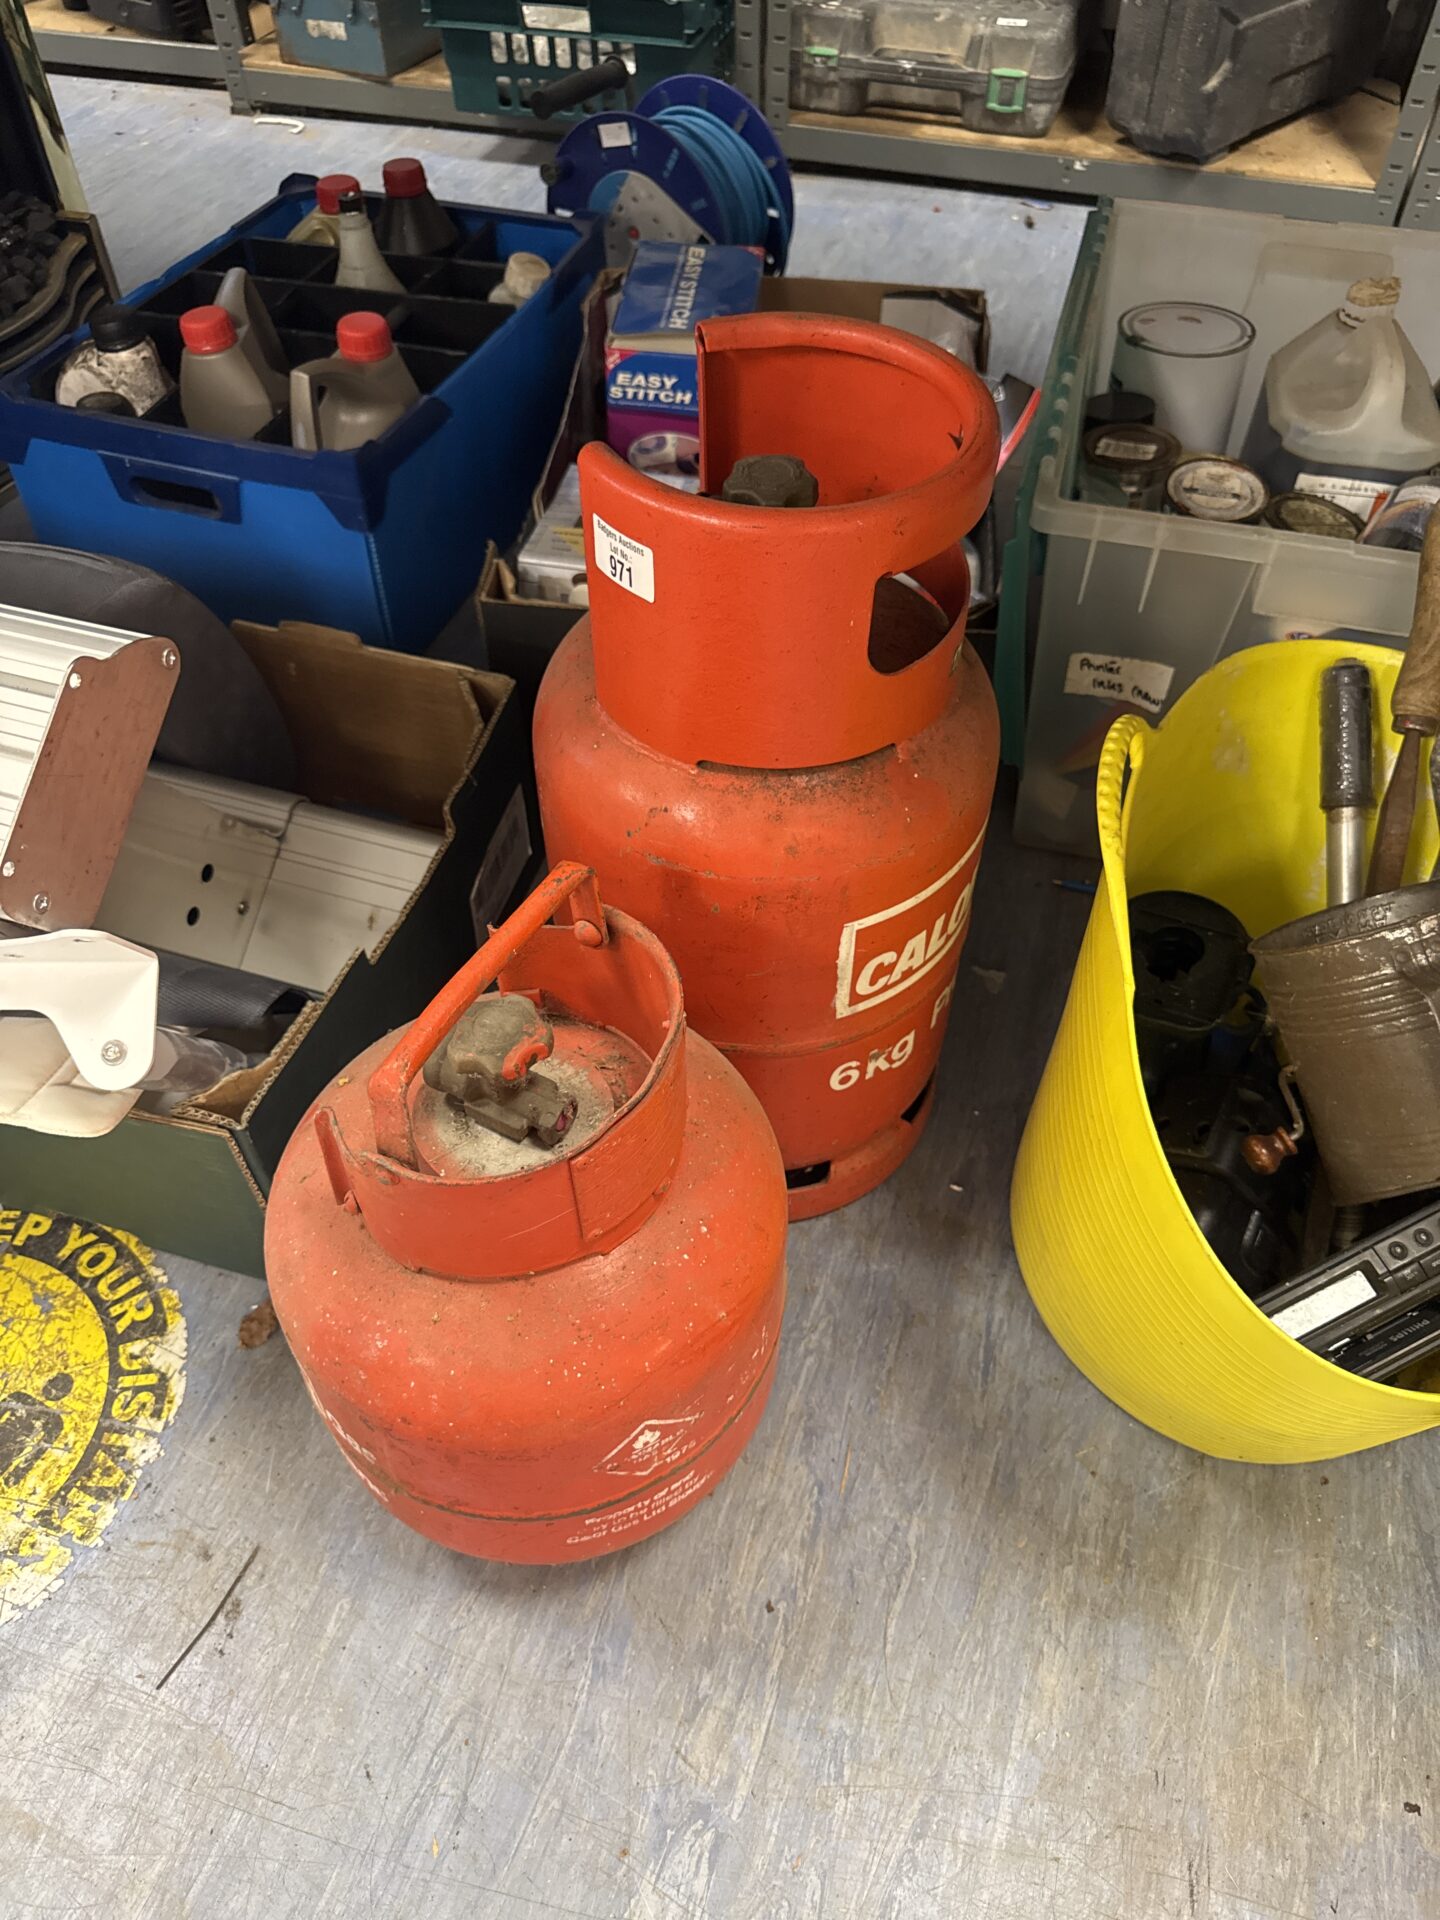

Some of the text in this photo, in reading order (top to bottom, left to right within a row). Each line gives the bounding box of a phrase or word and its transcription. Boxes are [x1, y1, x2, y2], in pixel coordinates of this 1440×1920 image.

[683, 246, 706, 280] EASY
[668, 280, 698, 330] STITCH
[616, 371, 679, 389] EASY
[608, 385, 693, 405] STITCH
[609, 542, 619, 556] Lot
[619, 535, 645, 557] Auctions
[609, 554, 632, 588] 971
[855, 882, 972, 996] CALO
[0, 1210, 53, 1246] EP
[56, 1222, 154, 1334] YOUR
[1389, 1318, 1430, 1342] PHILIPS
[585, 1498, 651, 1526] Property
